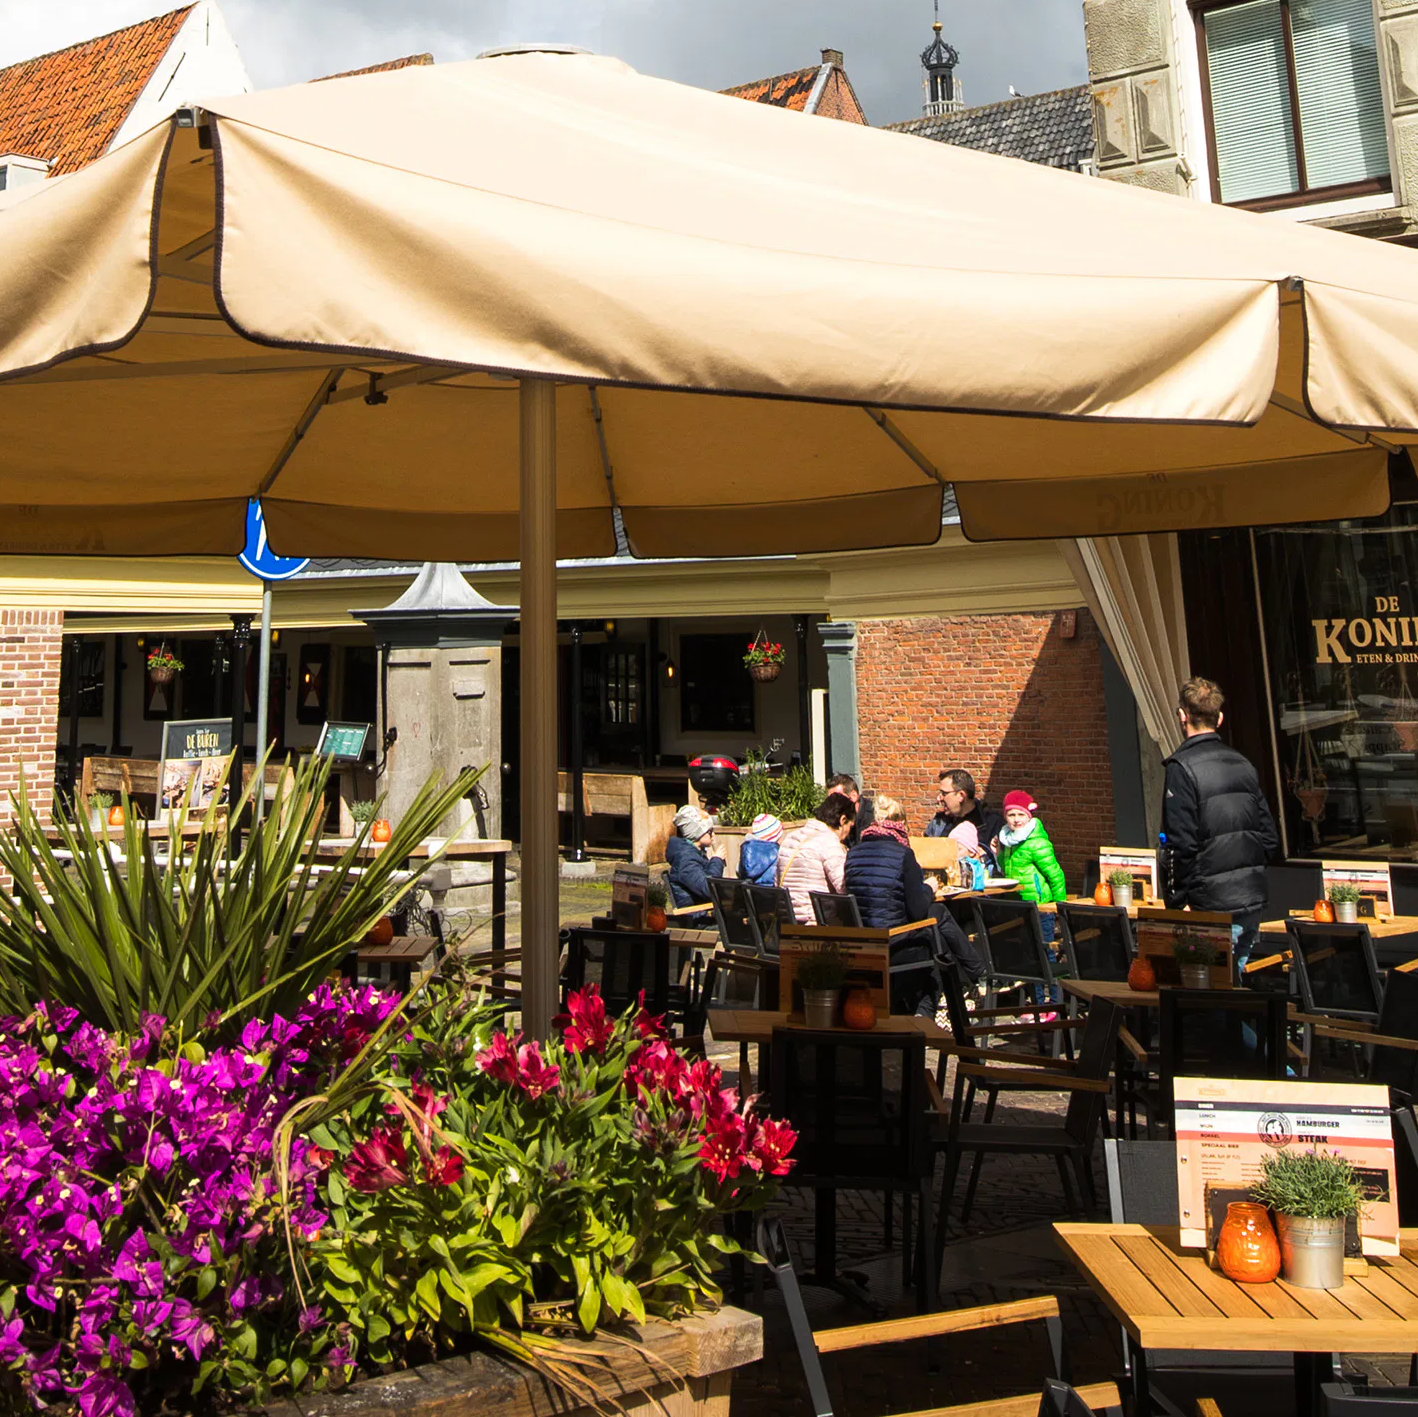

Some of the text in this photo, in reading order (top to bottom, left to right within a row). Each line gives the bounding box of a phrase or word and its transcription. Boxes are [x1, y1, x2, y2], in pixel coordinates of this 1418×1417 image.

[1375, 596, 1400, 613] DE
[1356, 653, 1383, 663] ETEN
[1385, 653, 1394, 663] &
[1296, 1119, 1340, 1129] HAMBURGER
[1298, 1134, 1328, 1144] STEAK
